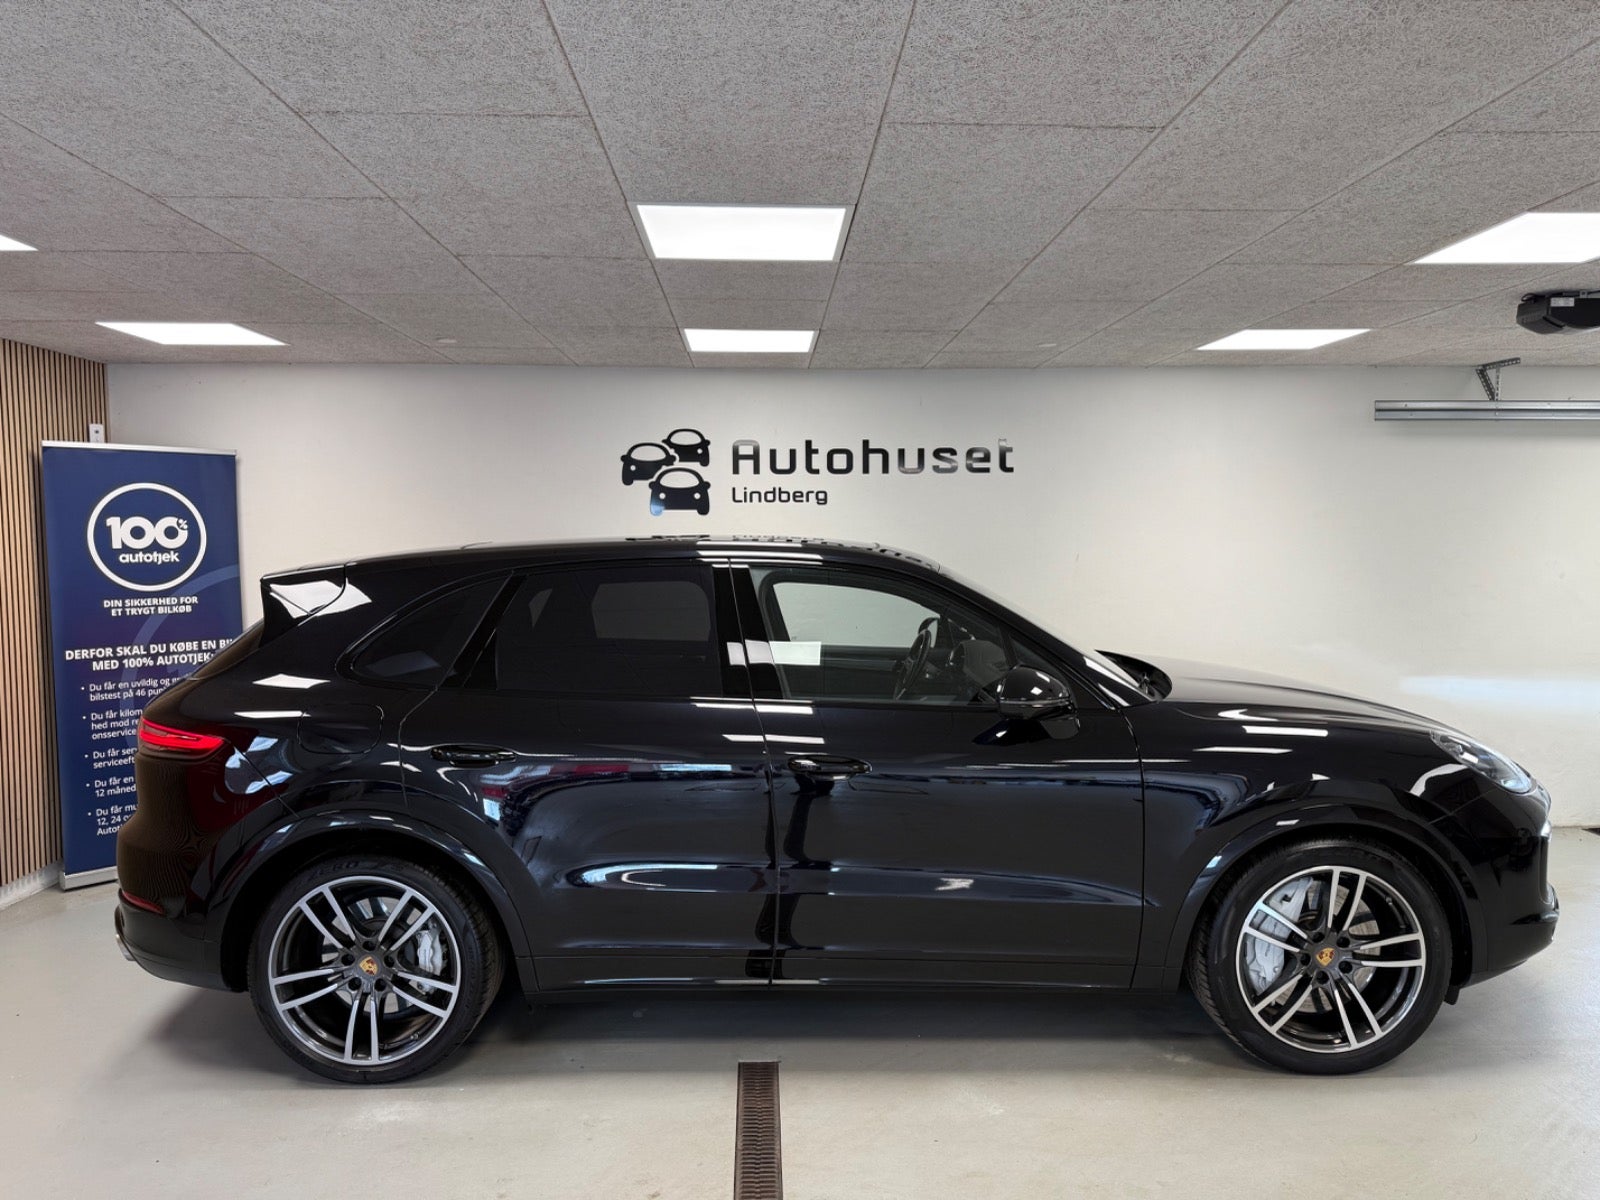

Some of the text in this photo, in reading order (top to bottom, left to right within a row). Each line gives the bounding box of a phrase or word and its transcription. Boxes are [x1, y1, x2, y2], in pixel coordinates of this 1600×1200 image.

[732, 437, 1014, 475] Autohuset
[731, 486, 828, 505] Lindberg
[106, 516, 189, 550] 100%
[118, 550, 180, 565] autotjek
[103, 596, 199, 608] DIN SIKKERHED FOR
[111, 605, 192, 617] ET TRYGT BILKØB
[65, 646, 113, 660] DERFOR
[116, 645, 147, 657] SKAL
[150, 643, 167, 654] DU
[169, 641, 198, 653] KØBE
[201, 640, 216, 650] EN
[92, 659, 119, 671] MED
[122, 658, 154, 669] 100%
[90, 684, 102, 692] Du
[104, 682, 116, 691] får
[131, 679, 158, 689] uvildig
[159, 679, 170, 687] og
[90, 692, 121, 702] bilstest
[123, 691, 134, 700] på
[135, 689, 147, 697] 46
[105, 711, 117, 719] får
[91, 723, 108, 731] hed
[110, 720, 129, 728] mod
[91, 730, 137, 740] onsservice
[94, 752, 105, 760] Du
[107, 749, 119, 757] får
[93, 757, 136, 769] serviceeft
[95, 780, 107, 788] Du
[109, 777, 121, 786] får
[96, 784, 137, 798] 12 måned
[96, 809, 109, 817] Du
[110, 805, 123, 814] får
[97, 818, 109, 826] 12,
[110, 816, 122, 824] 24
